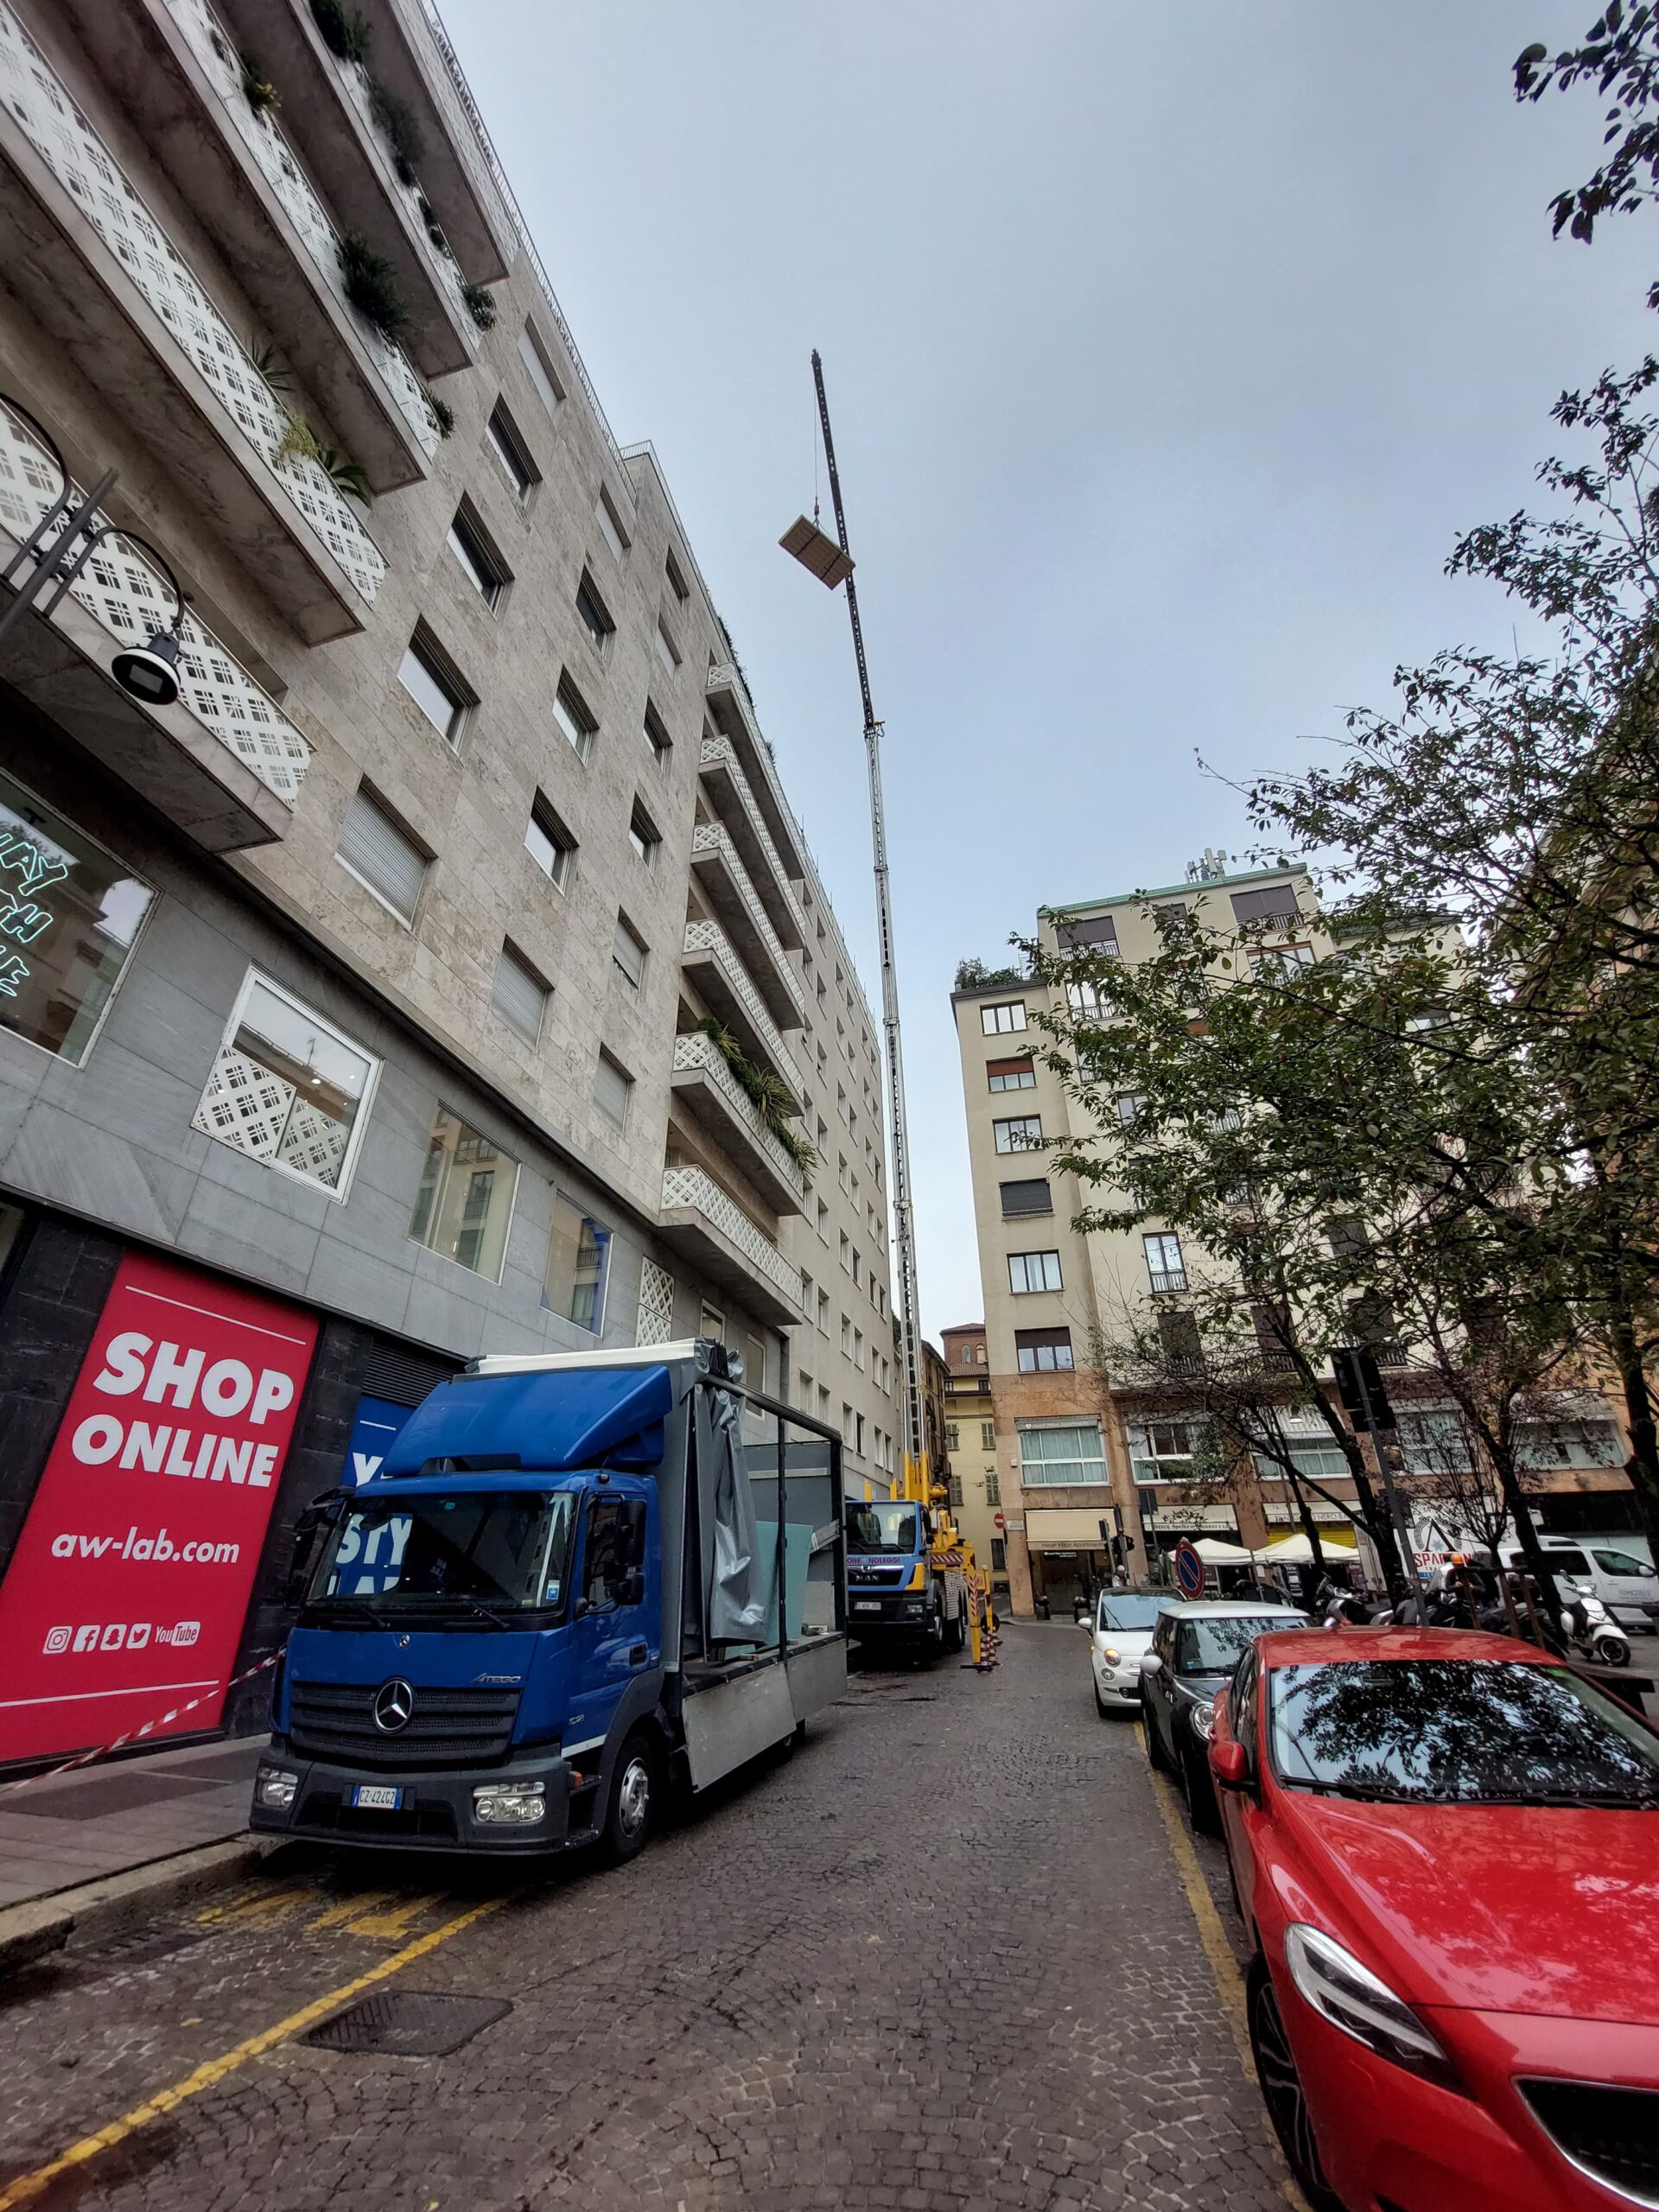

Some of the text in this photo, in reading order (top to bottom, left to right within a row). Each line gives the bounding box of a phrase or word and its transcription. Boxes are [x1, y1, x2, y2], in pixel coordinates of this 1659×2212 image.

[0, 833, 68, 896] AY
[93, 1332, 294, 1425] SHOP
[73, 1414, 278, 1487] ONLINE
[353, 1452, 394, 1487] Y
[52, 1527, 240, 1563] aw-lab.com
[335, 1514, 413, 1565] STY
[471, 1673, 521, 1684] ATEGO
